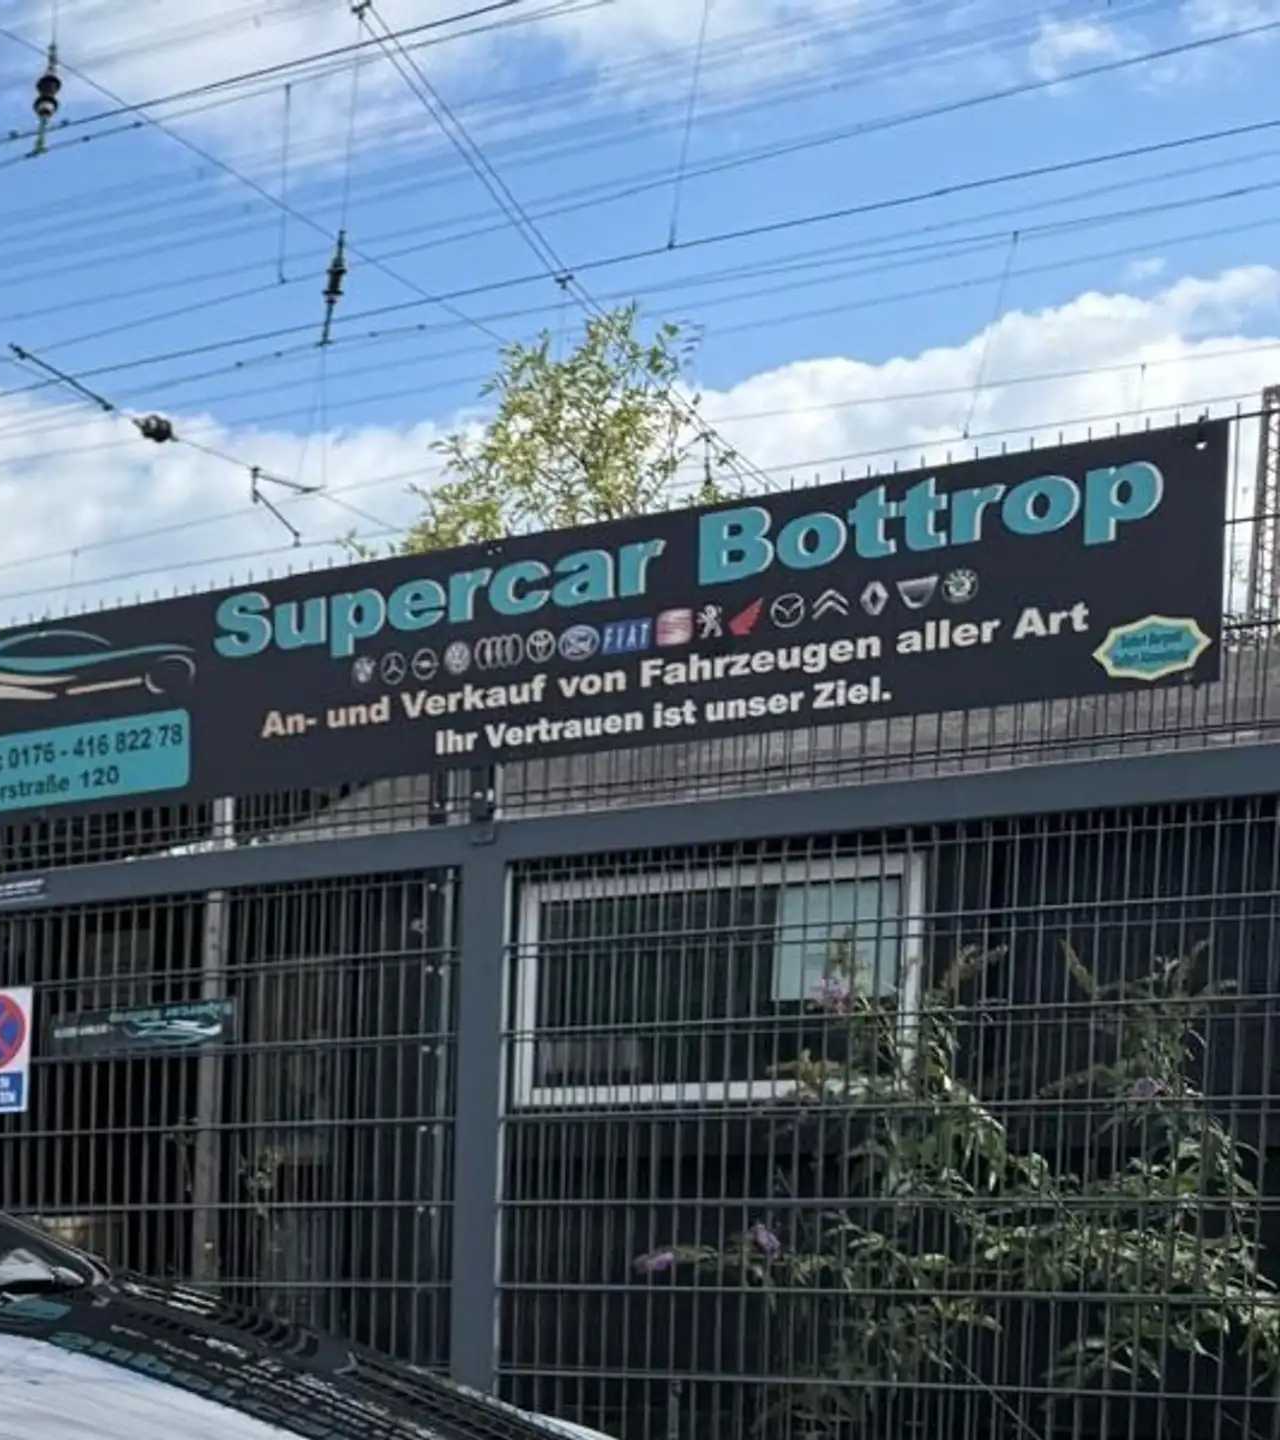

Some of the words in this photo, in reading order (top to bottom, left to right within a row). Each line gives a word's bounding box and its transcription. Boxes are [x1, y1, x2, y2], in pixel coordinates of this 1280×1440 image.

[213, 538, 665, 661] Supercar
[698, 460, 1164, 586] Bottrop
[602, 620, 650, 650] FIAT
[262, 708, 318, 740] An-
[326, 694, 392, 728] und
[400, 673, 549, 722] Verkauf
[559, 669, 627, 700] von
[641, 632, 882, 690] Fahrzeugen
[895, 617, 1001, 656] aller
[1013, 601, 1090, 640] Art
[115, 729, 152, 752] 822
[156, 723, 183, 747] 78
[436, 724, 478, 757] Ihr
[484, 705, 645, 751] Vertrauen
[653, 701, 698, 728] ist
[705, 692, 805, 724] unser
[813, 676, 893, 709] Ziel.
[79, 765, 120, 790] 120
